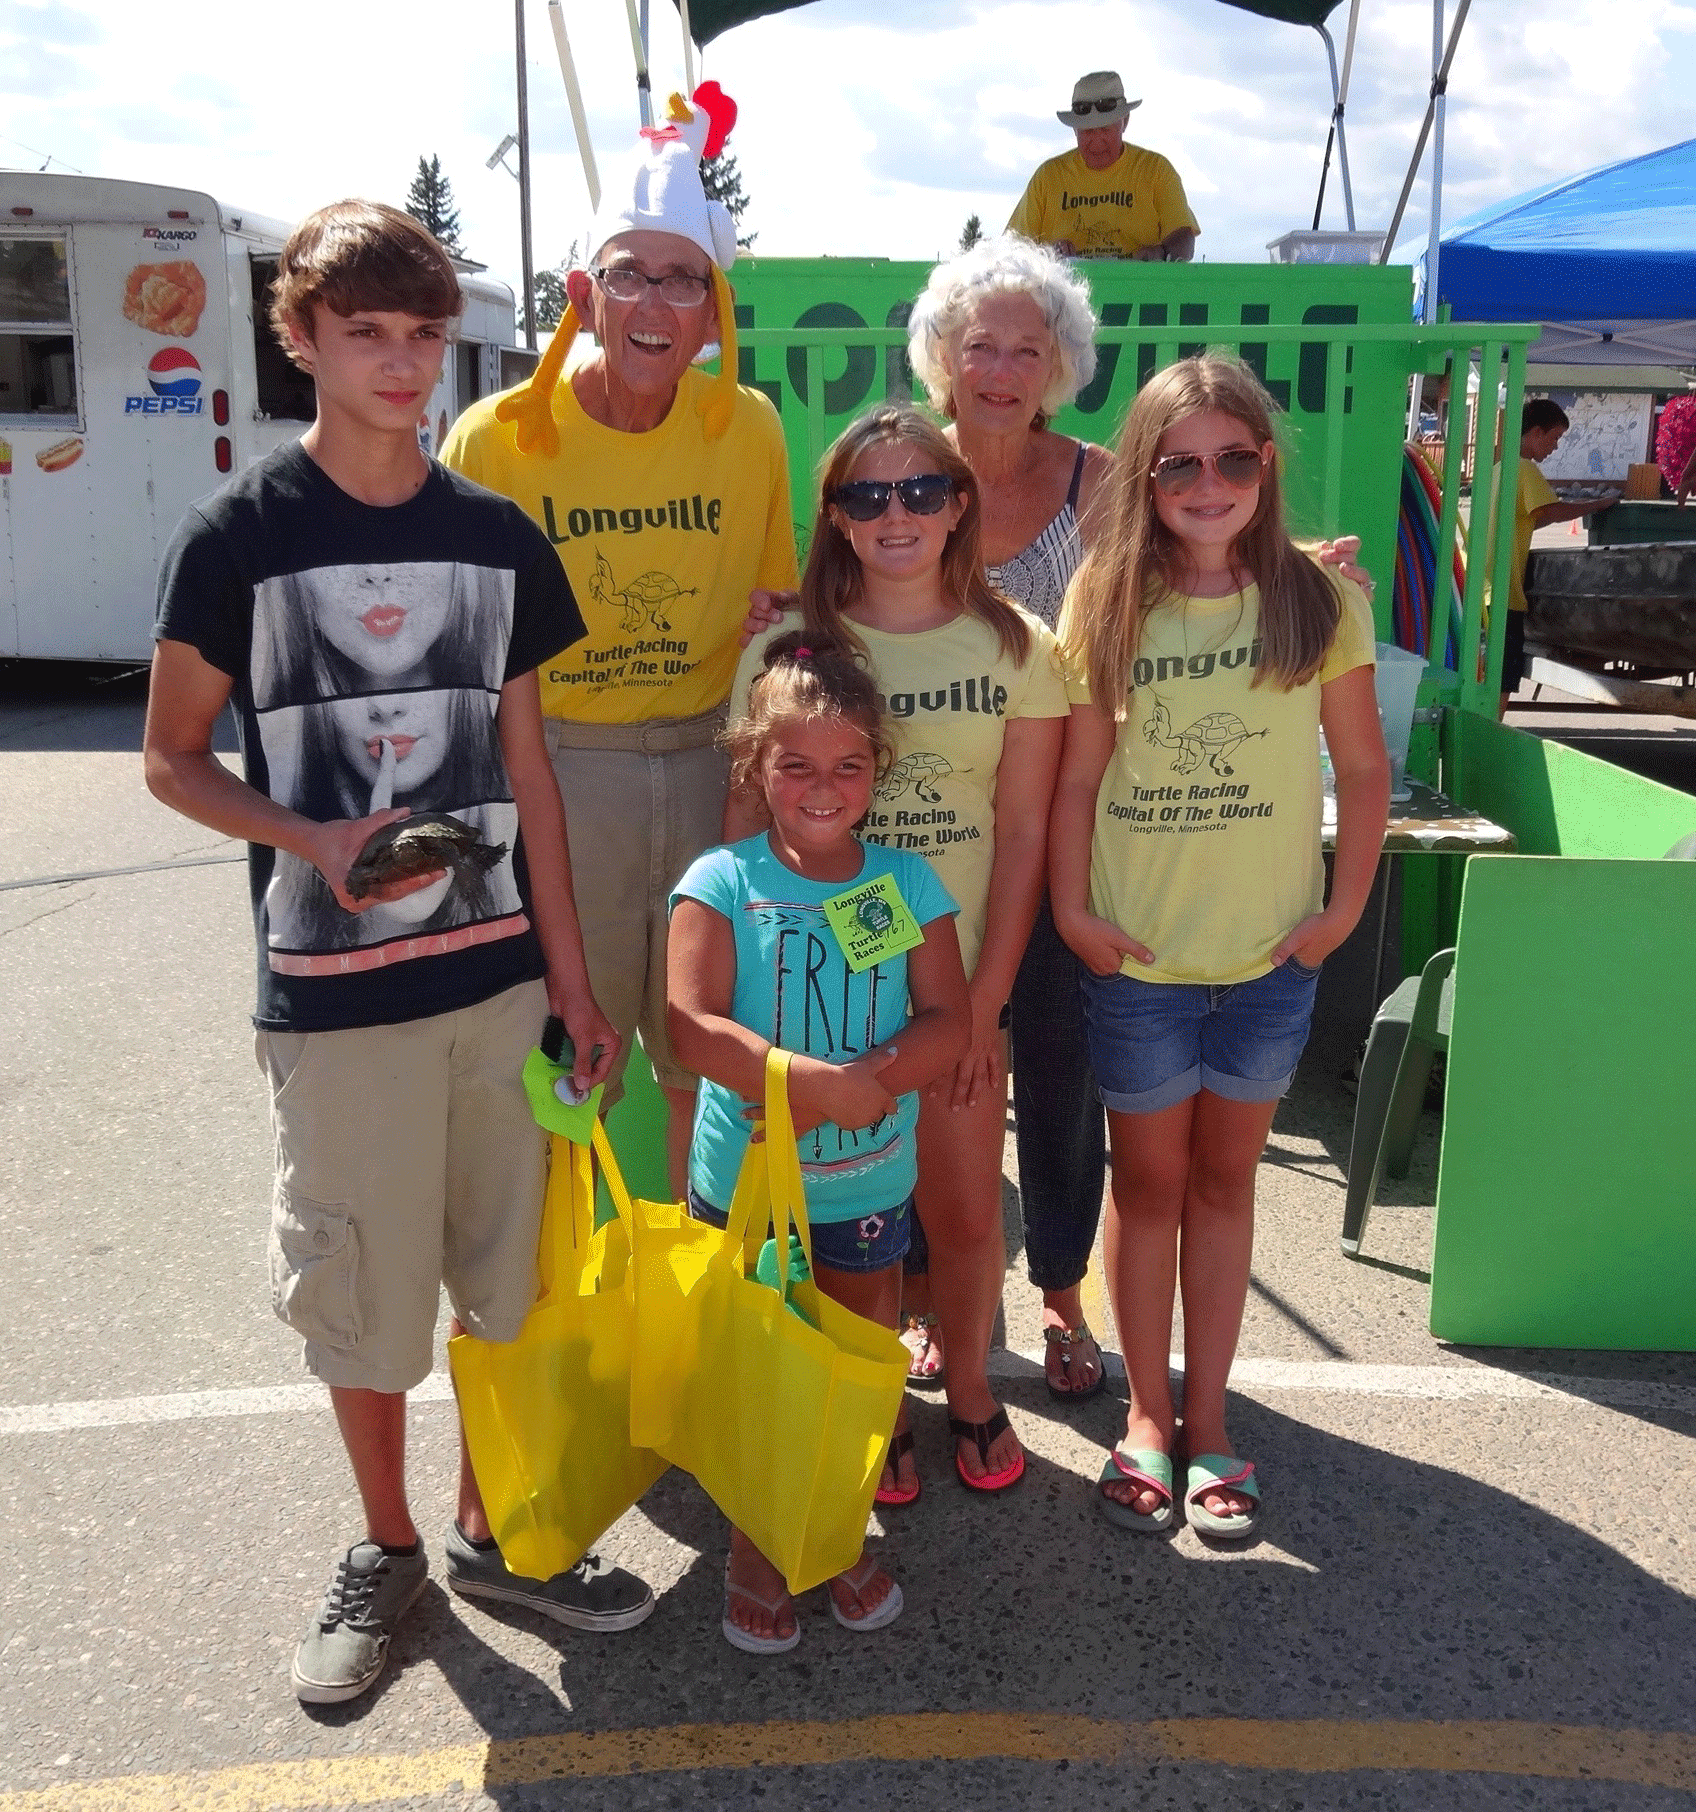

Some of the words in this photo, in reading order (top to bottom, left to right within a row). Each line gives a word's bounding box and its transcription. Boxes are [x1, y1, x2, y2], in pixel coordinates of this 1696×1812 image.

[1061, 190, 1134, 211] Longville
[735, 301, 1359, 416] LOVILE
[124, 396, 204, 415] PEPSI
[542, 494, 722, 545] Longville
[583, 644, 633, 664] Turtle
[634, 637, 689, 656] Racing
[549, 668, 611, 685] Capital
[629, 660, 658, 675] The
[663, 659, 701, 675] Wor
[1127, 638, 1264, 694] ongvi
[622, 678, 674, 688] Minnesota
[876, 675, 1008, 719] ngville
[1131, 785, 1183, 802] Turtle
[1187, 782, 1250, 800] Racing
[864, 811, 889, 827] tle
[895, 808, 957, 825] Racing
[1107, 801, 1154, 823] Capital
[1159, 806, 1181, 822] Of
[1185, 805, 1213, 821] The
[1218, 802, 1274, 820] World
[866, 833, 890, 846] Of
[894, 832, 930, 849] The
[935, 825, 980, 845] World
[1129, 823, 1176, 835] Longville,
[833, 883, 886, 911] Longville
[848, 930, 883, 950] Turtle
[853, 942, 885, 961] Races
